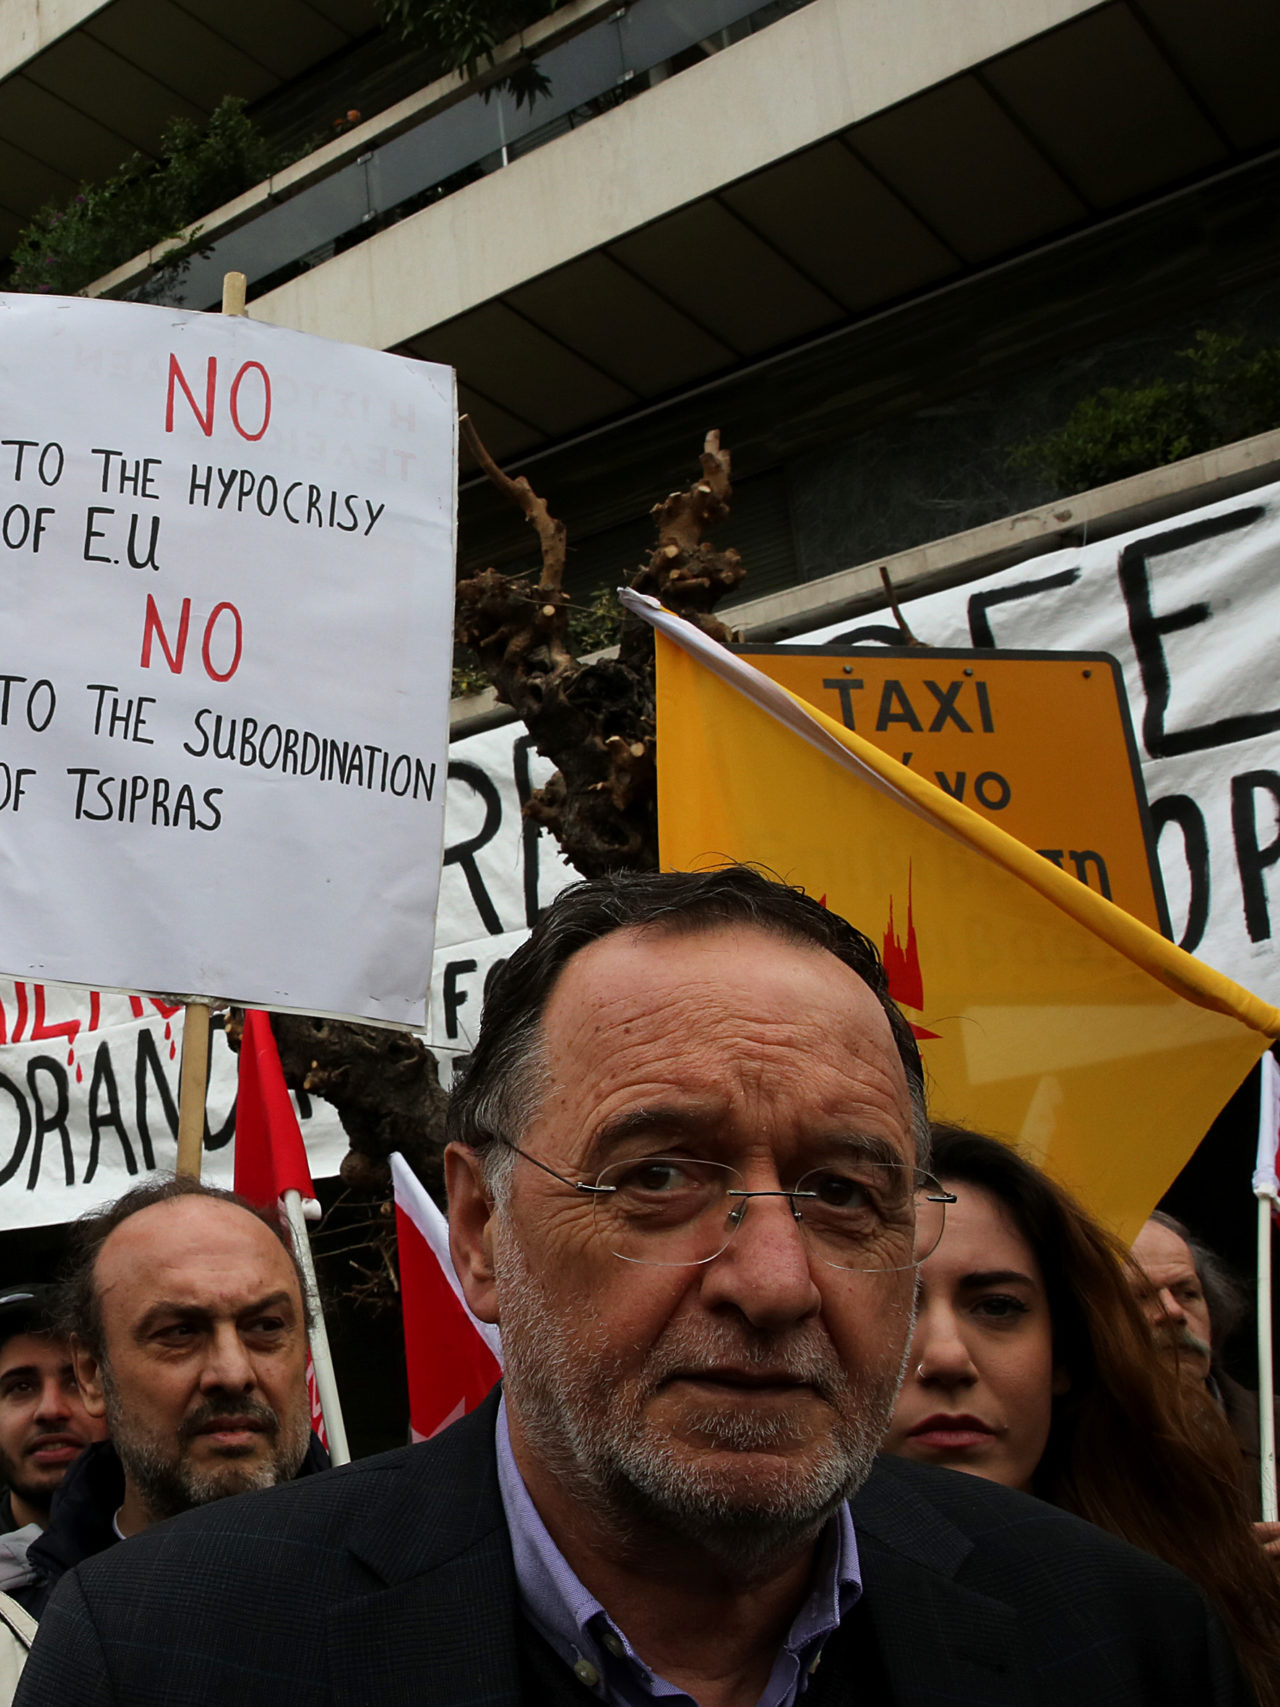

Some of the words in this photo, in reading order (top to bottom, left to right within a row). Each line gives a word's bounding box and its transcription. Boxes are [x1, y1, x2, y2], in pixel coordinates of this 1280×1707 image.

[165, 353, 272, 441] NO
[1, 440, 64, 486] TO
[92, 449, 162, 499] THE
[189, 464, 385, 536] HYPOCRISY
[2, 504, 55, 553] OF
[83, 507, 161, 571] E.U
[140, 593, 243, 682] NO
[87, 684, 156, 745] THE
[183, 708, 436, 801] SUBORDINATION
[823, 678, 994, 733] TAXI
[67, 768, 224, 831] TSIPRAS
